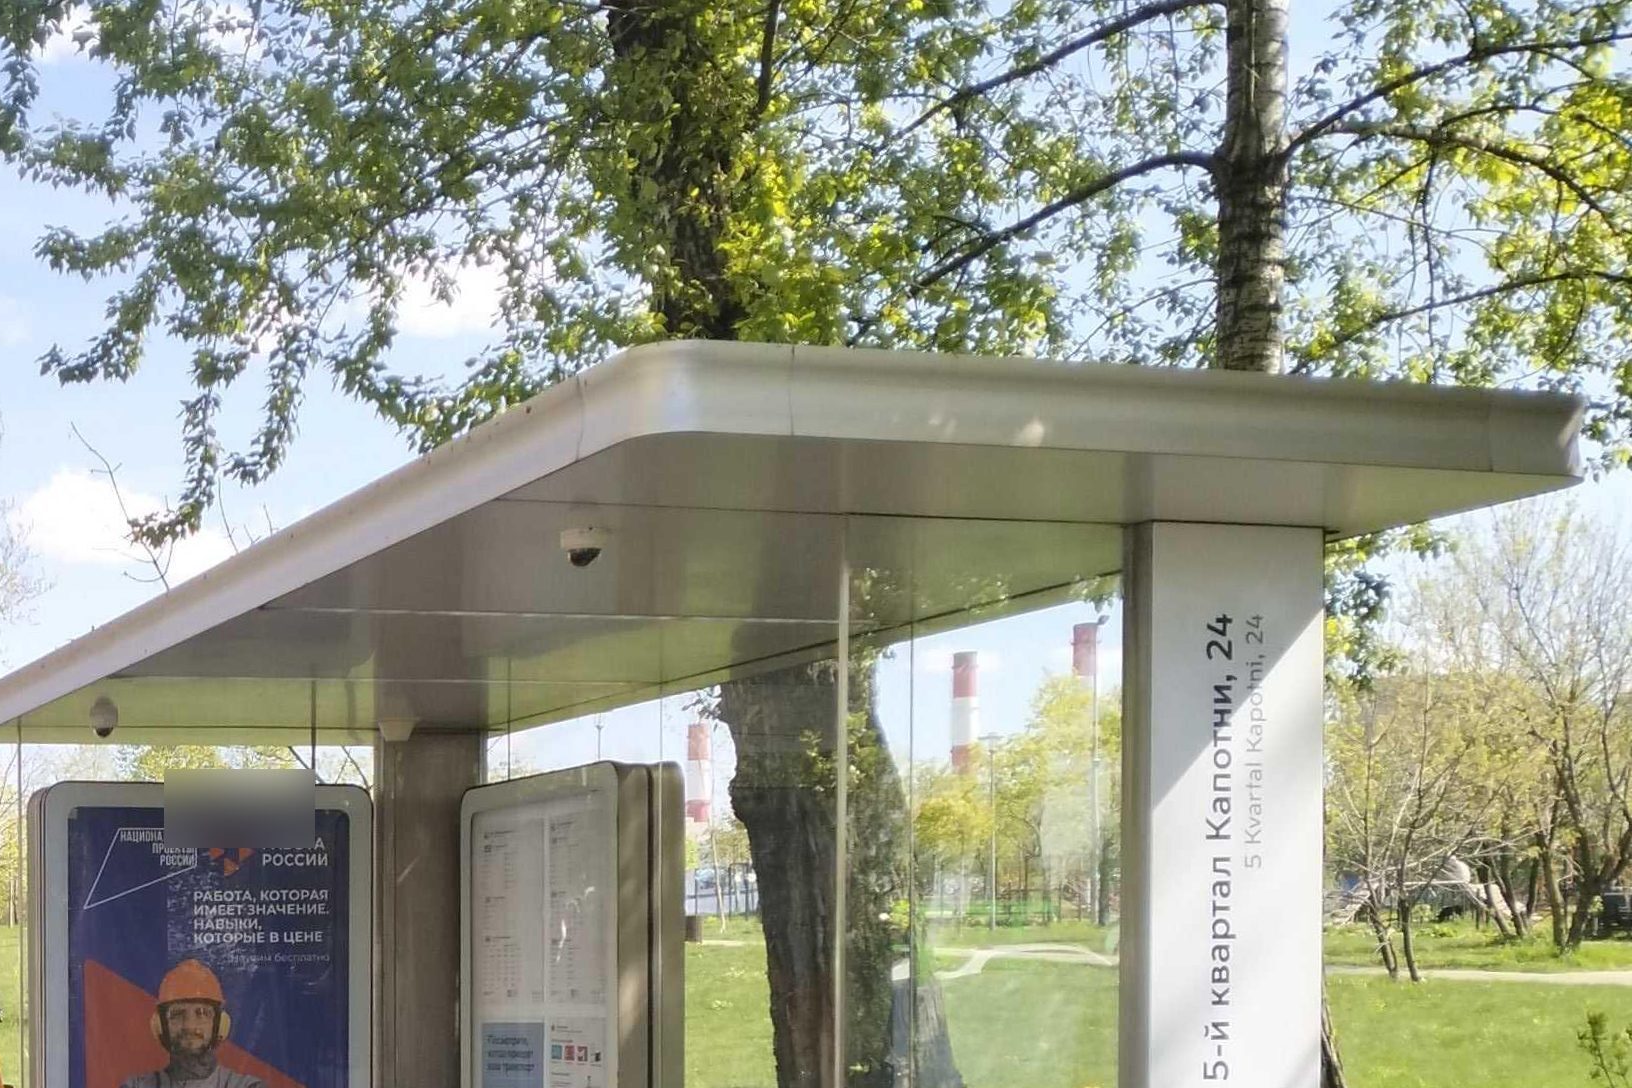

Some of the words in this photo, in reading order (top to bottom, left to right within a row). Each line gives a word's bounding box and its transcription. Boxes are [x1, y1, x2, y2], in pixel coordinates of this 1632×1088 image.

[1206, 613, 1234, 660] 24
[1245, 614, 1264, 644] 24
[1245, 654, 1267, 752] Kapotni,
[1205, 673, 1238, 840] Капотни,
[1244, 762, 1264, 844] Kvartal
[119, 830, 165, 843] НАЦИОНА
[159, 854, 196, 867] РОССИИ
[261, 853, 329, 867] РОССИИ
[1244, 854, 1262, 869] 5
[193, 890, 257, 903] РАБОТА,
[260, 889, 329, 901] КОТОРАЯ
[193, 904, 244, 916] ИМЕЕТ
[247, 903, 330, 915] ЗНАЧЕНИЕ.
[193, 918, 263, 931] НАВЫКИ,
[1210, 856, 1237, 1006] квартал
[193, 932, 265, 944] КОТОРЫЕ
[270, 932, 280, 943] В
[283, 931, 323, 945] ЦЕНЕ
[1203, 1020, 1230, 1081] 5-й
